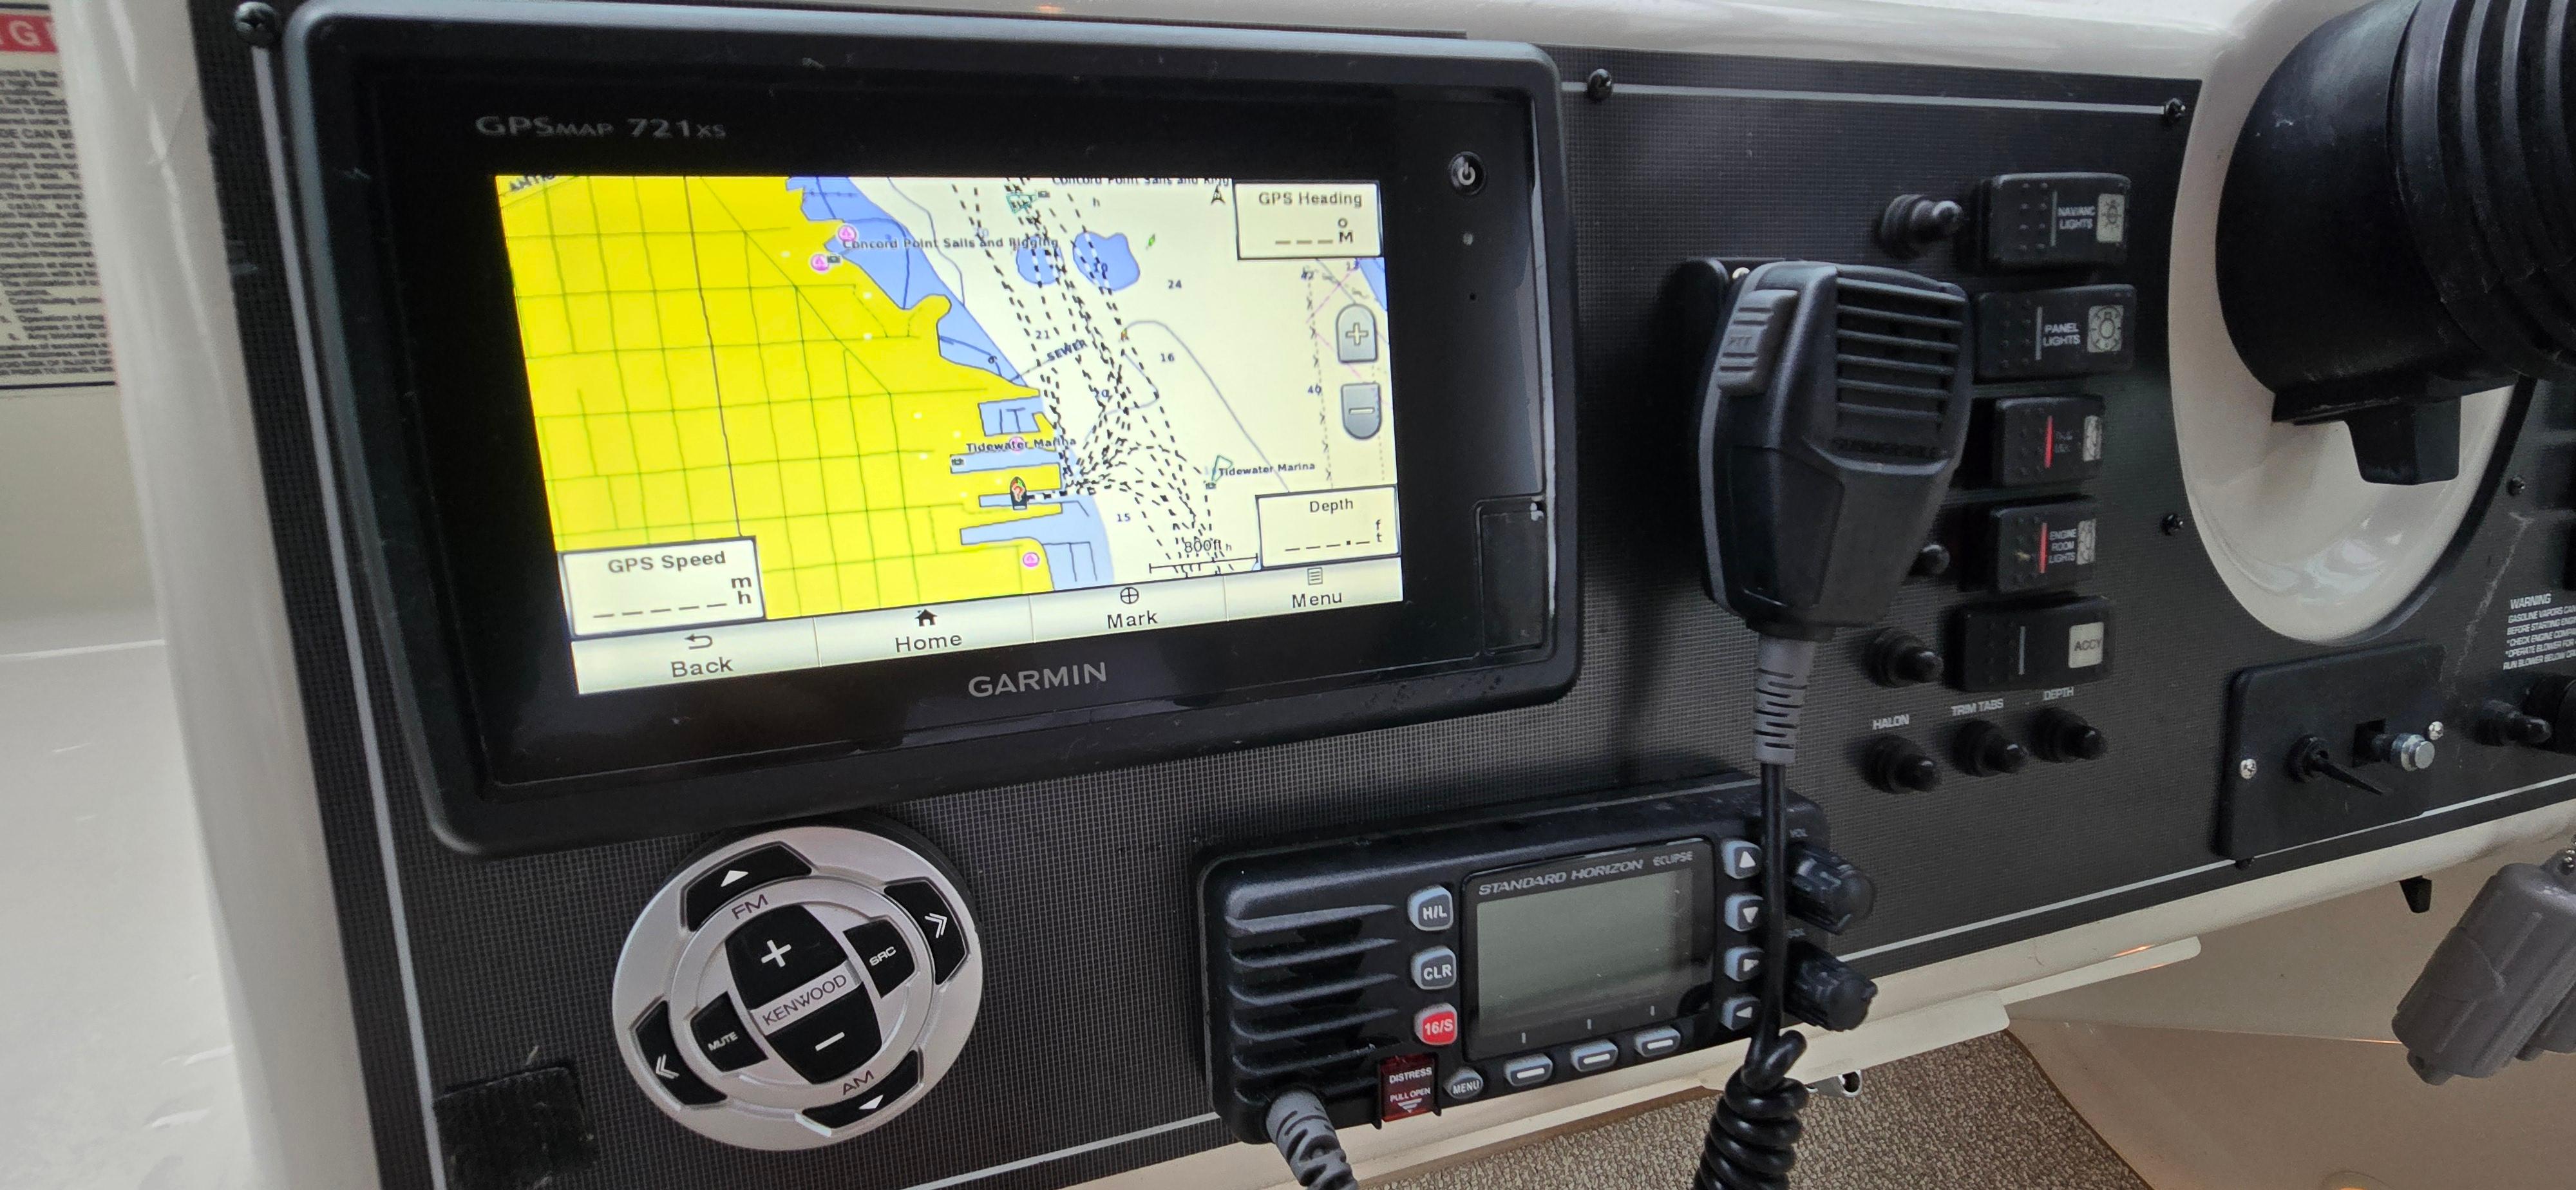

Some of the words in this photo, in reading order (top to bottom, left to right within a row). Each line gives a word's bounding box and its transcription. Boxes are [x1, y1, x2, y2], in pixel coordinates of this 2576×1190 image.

[1258, 192, 1293, 205] GPS
[1298, 191, 1363, 208] Heading
[2059, 218, 2094, 230] LIGHTS
[842, 238, 898, 249] Concord
[904, 238, 938, 249] Point
[943, 238, 975, 249] Sails
[979, 238, 1004, 248] and
[1009, 236, 1059, 251] Rigging
[1339, 231, 1354, 243] M
[1167, 279, 1182, 290] 24
[1035, 330, 1050, 339] 21
[2044, 322, 2079, 334] PANEL
[2042, 334, 2081, 347] LIGHTS
[1046, 339, 1088, 362] SEWER
[1160, 353, 1175, 363] 16
[966, 439, 1028, 453] Tidewater
[1033, 436, 1077, 450] Marina
[1218, 464, 1274, 477] Tidewater
[1278, 462, 1316, 473] Marina
[1309, 498, 1354, 515] Depth
[1116, 513, 1132, 522] 15
[2051, 540, 2075, 552] ROOM
[607, 554, 654, 574] GPS
[661, 551, 726, 572] Speed
[730, 576, 753, 589] m
[737, 590, 752, 605] h
[1291, 590, 1343, 609] Menu
[2510, 593, 2552, 610] WARNING
[1107, 610, 1159, 630] Mark
[2508, 611, 2539, 623] GASOLINE
[2506, 623, 2530, 636] BEFORE
[895, 632, 962, 653] Home
[670, 656, 734, 678] Back
[967, 661, 1108, 699] GARMIN
[2043, 686, 2074, 701] DEPTH
[1951, 703, 1976, 717] TRIM
[1978, 698, 2004, 712] TABS
[1872, 714, 1909, 730] HALON
[1478, 871, 1567, 896] STANDARD
[1570, 858, 1644, 882] HORIZON
[1653, 851, 1694, 866] ECLIPSE
[730, 894, 769, 920] FM
[1422, 905, 1448, 921] H/L
[869, 945, 897, 967] SRC
[1423, 963, 1452, 981] CLR
[762, 973, 848, 1026] KENWOOD
[1425, 1018, 1454, 1035] 16/S
[708, 1031, 739, 1052] MUTE
[841, 1069, 875, 1095] AM
[1388, 1066, 1432, 1084] DISTRESS
[1389, 1091, 1408, 1102] PULL
[1409, 1087, 1431, 1098] OPEN
[1452, 1079, 1480, 1095] MENU
